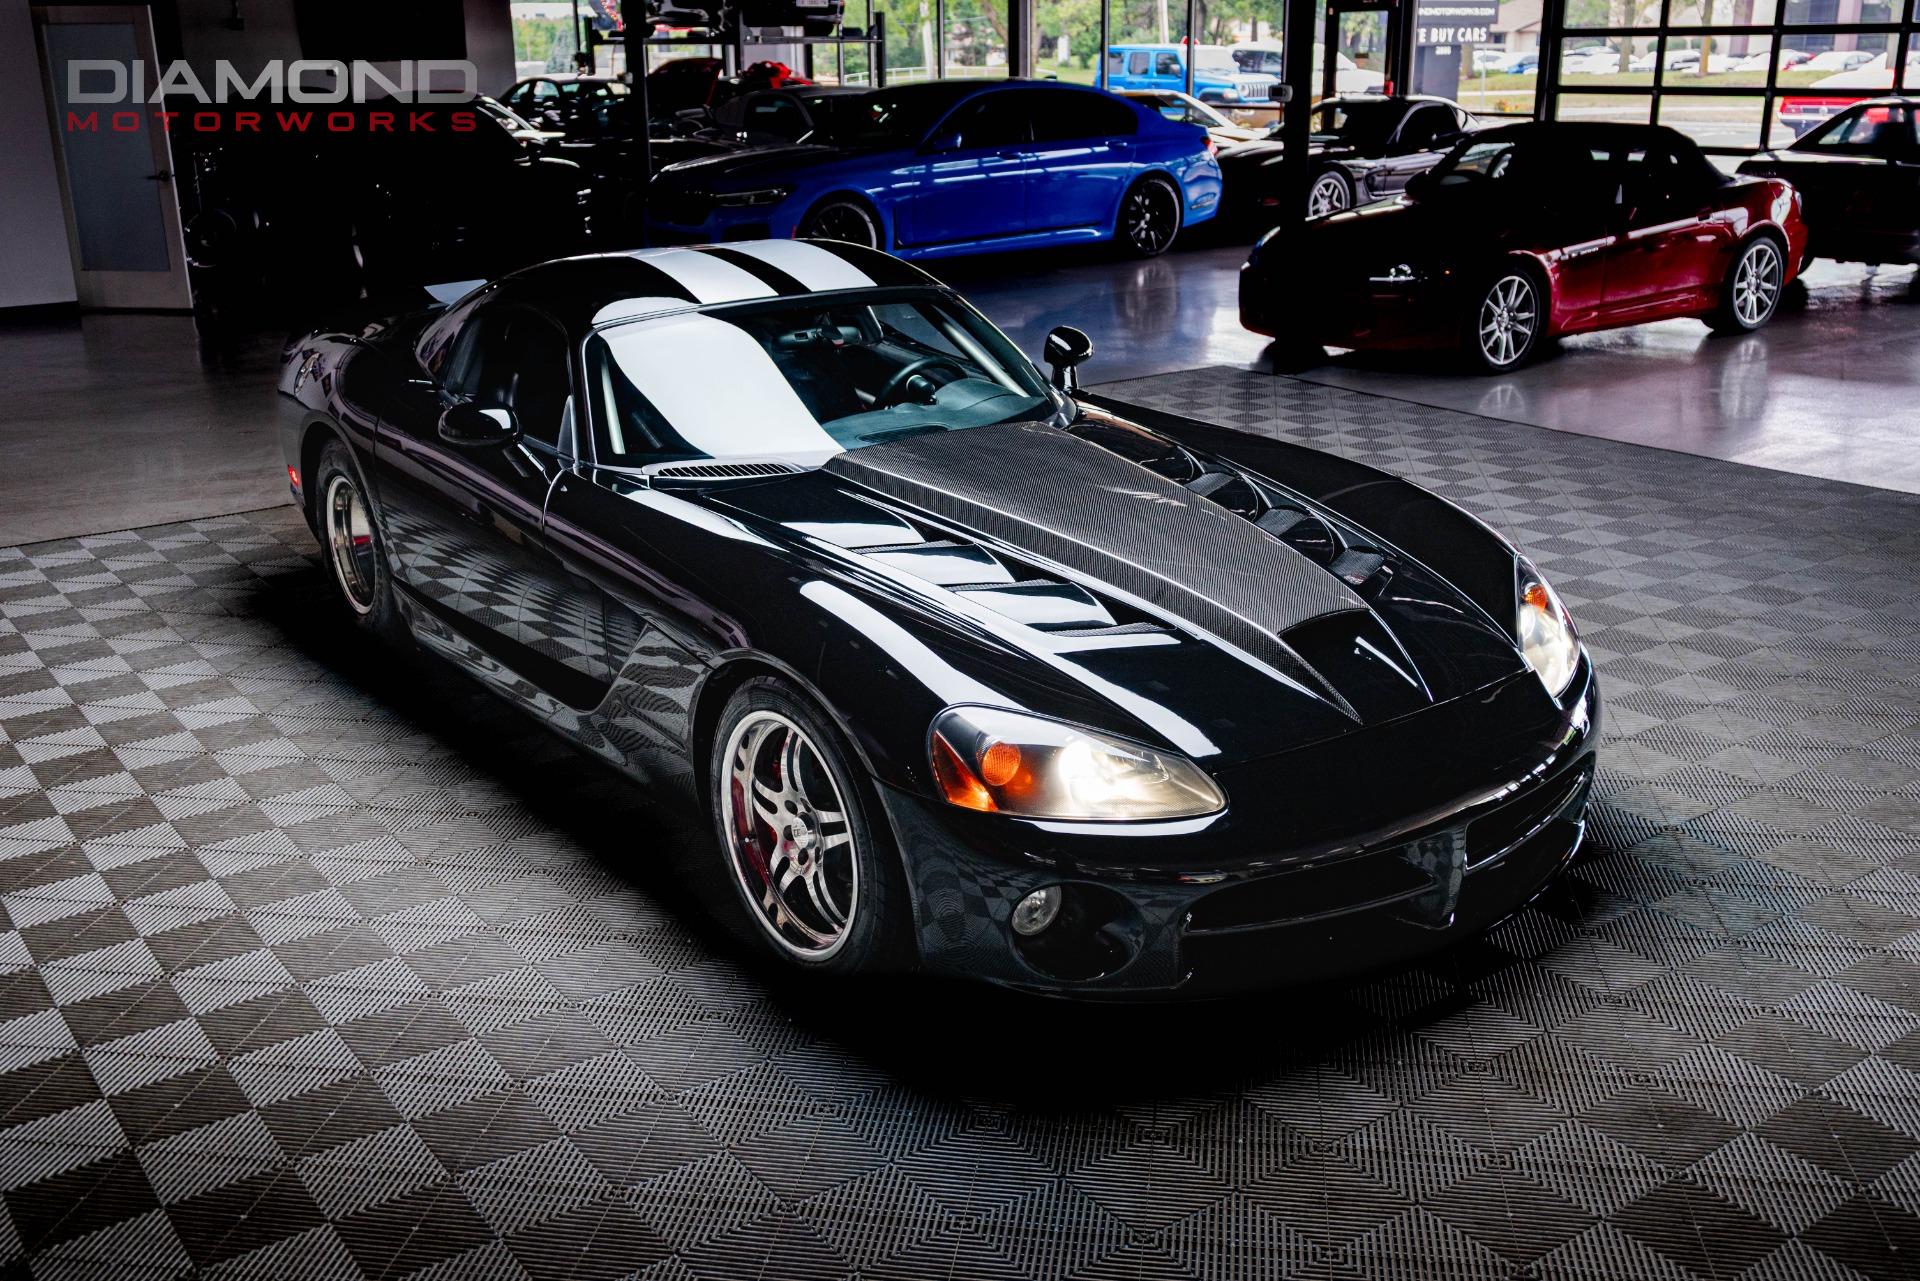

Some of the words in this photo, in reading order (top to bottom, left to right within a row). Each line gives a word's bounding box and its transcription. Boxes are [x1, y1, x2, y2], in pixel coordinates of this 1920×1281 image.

[1417, 28, 1427, 43] E
[1430, 28, 1455, 43] BUY
[1457, 27, 1487, 42] CARS
